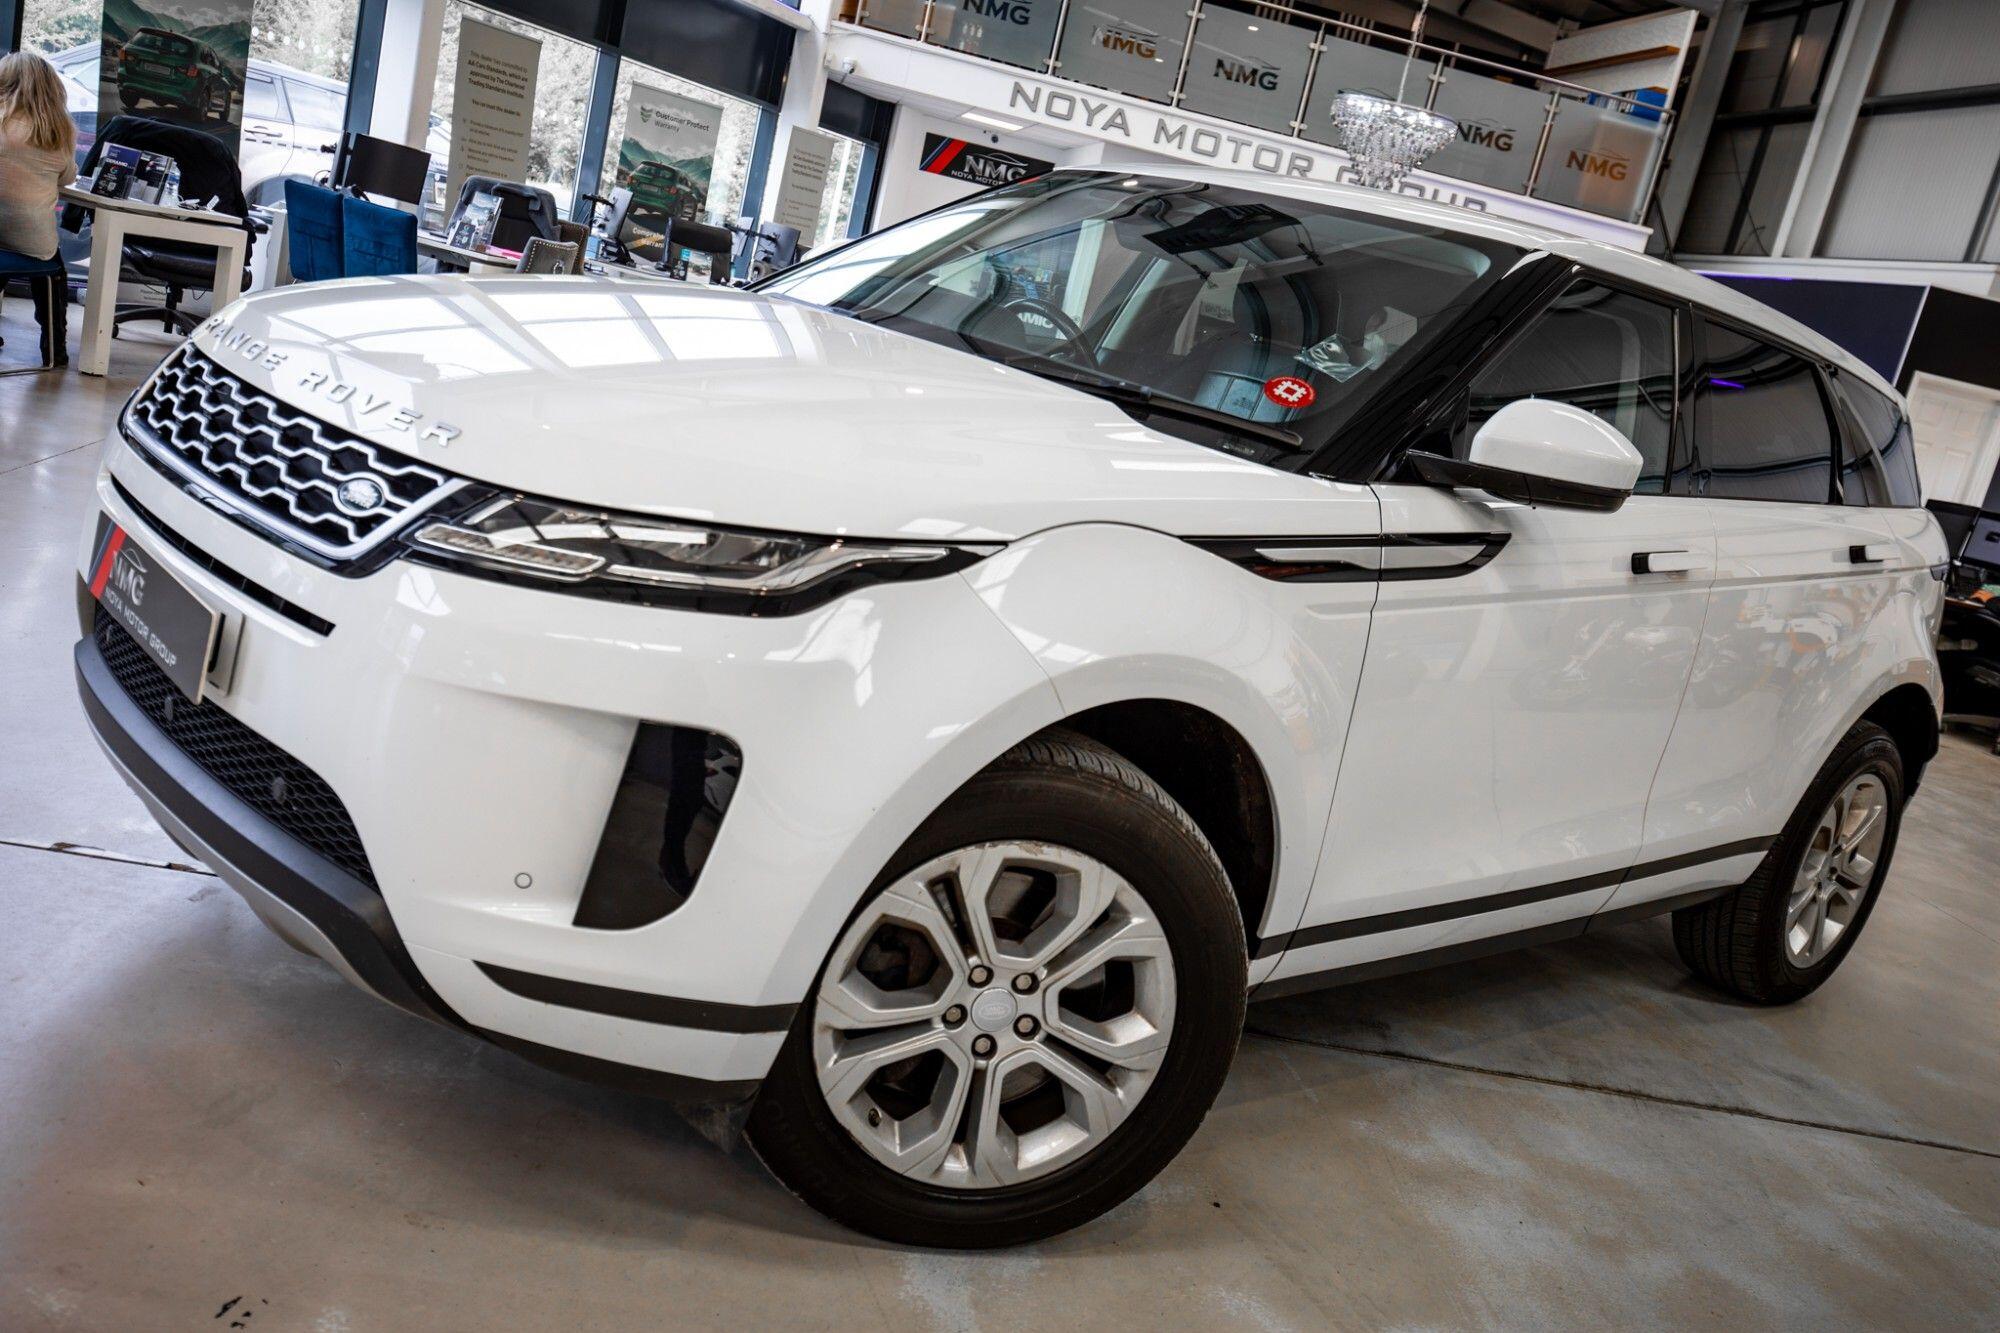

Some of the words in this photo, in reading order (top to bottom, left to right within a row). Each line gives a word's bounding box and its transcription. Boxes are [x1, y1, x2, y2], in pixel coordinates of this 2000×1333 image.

[962, 0, 1031, 26] NMG
[1213, 58, 1280, 91] NMG
[655, 110, 686, 125] Customer
[686, 119, 710, 132] Protect
[1009, 81, 1131, 137] NOYA
[1153, 117, 1314, 179] MOTOR
[1456, 121, 1514, 152] NMG
[951, 170, 973, 180] NOYA
[975, 176, 1005, 186] MOTO
[963, 154, 1027, 182] NMG
[1565, 149, 1628, 182] NMG
[205, 314, 289, 372] RANGE
[300, 372, 463, 447] ROVER
[109, 550, 145, 606] NMG
[104, 586, 123, 612] NOYA
[123, 605, 149, 641] MOTOR
[149, 632, 178, 667] GROUP
